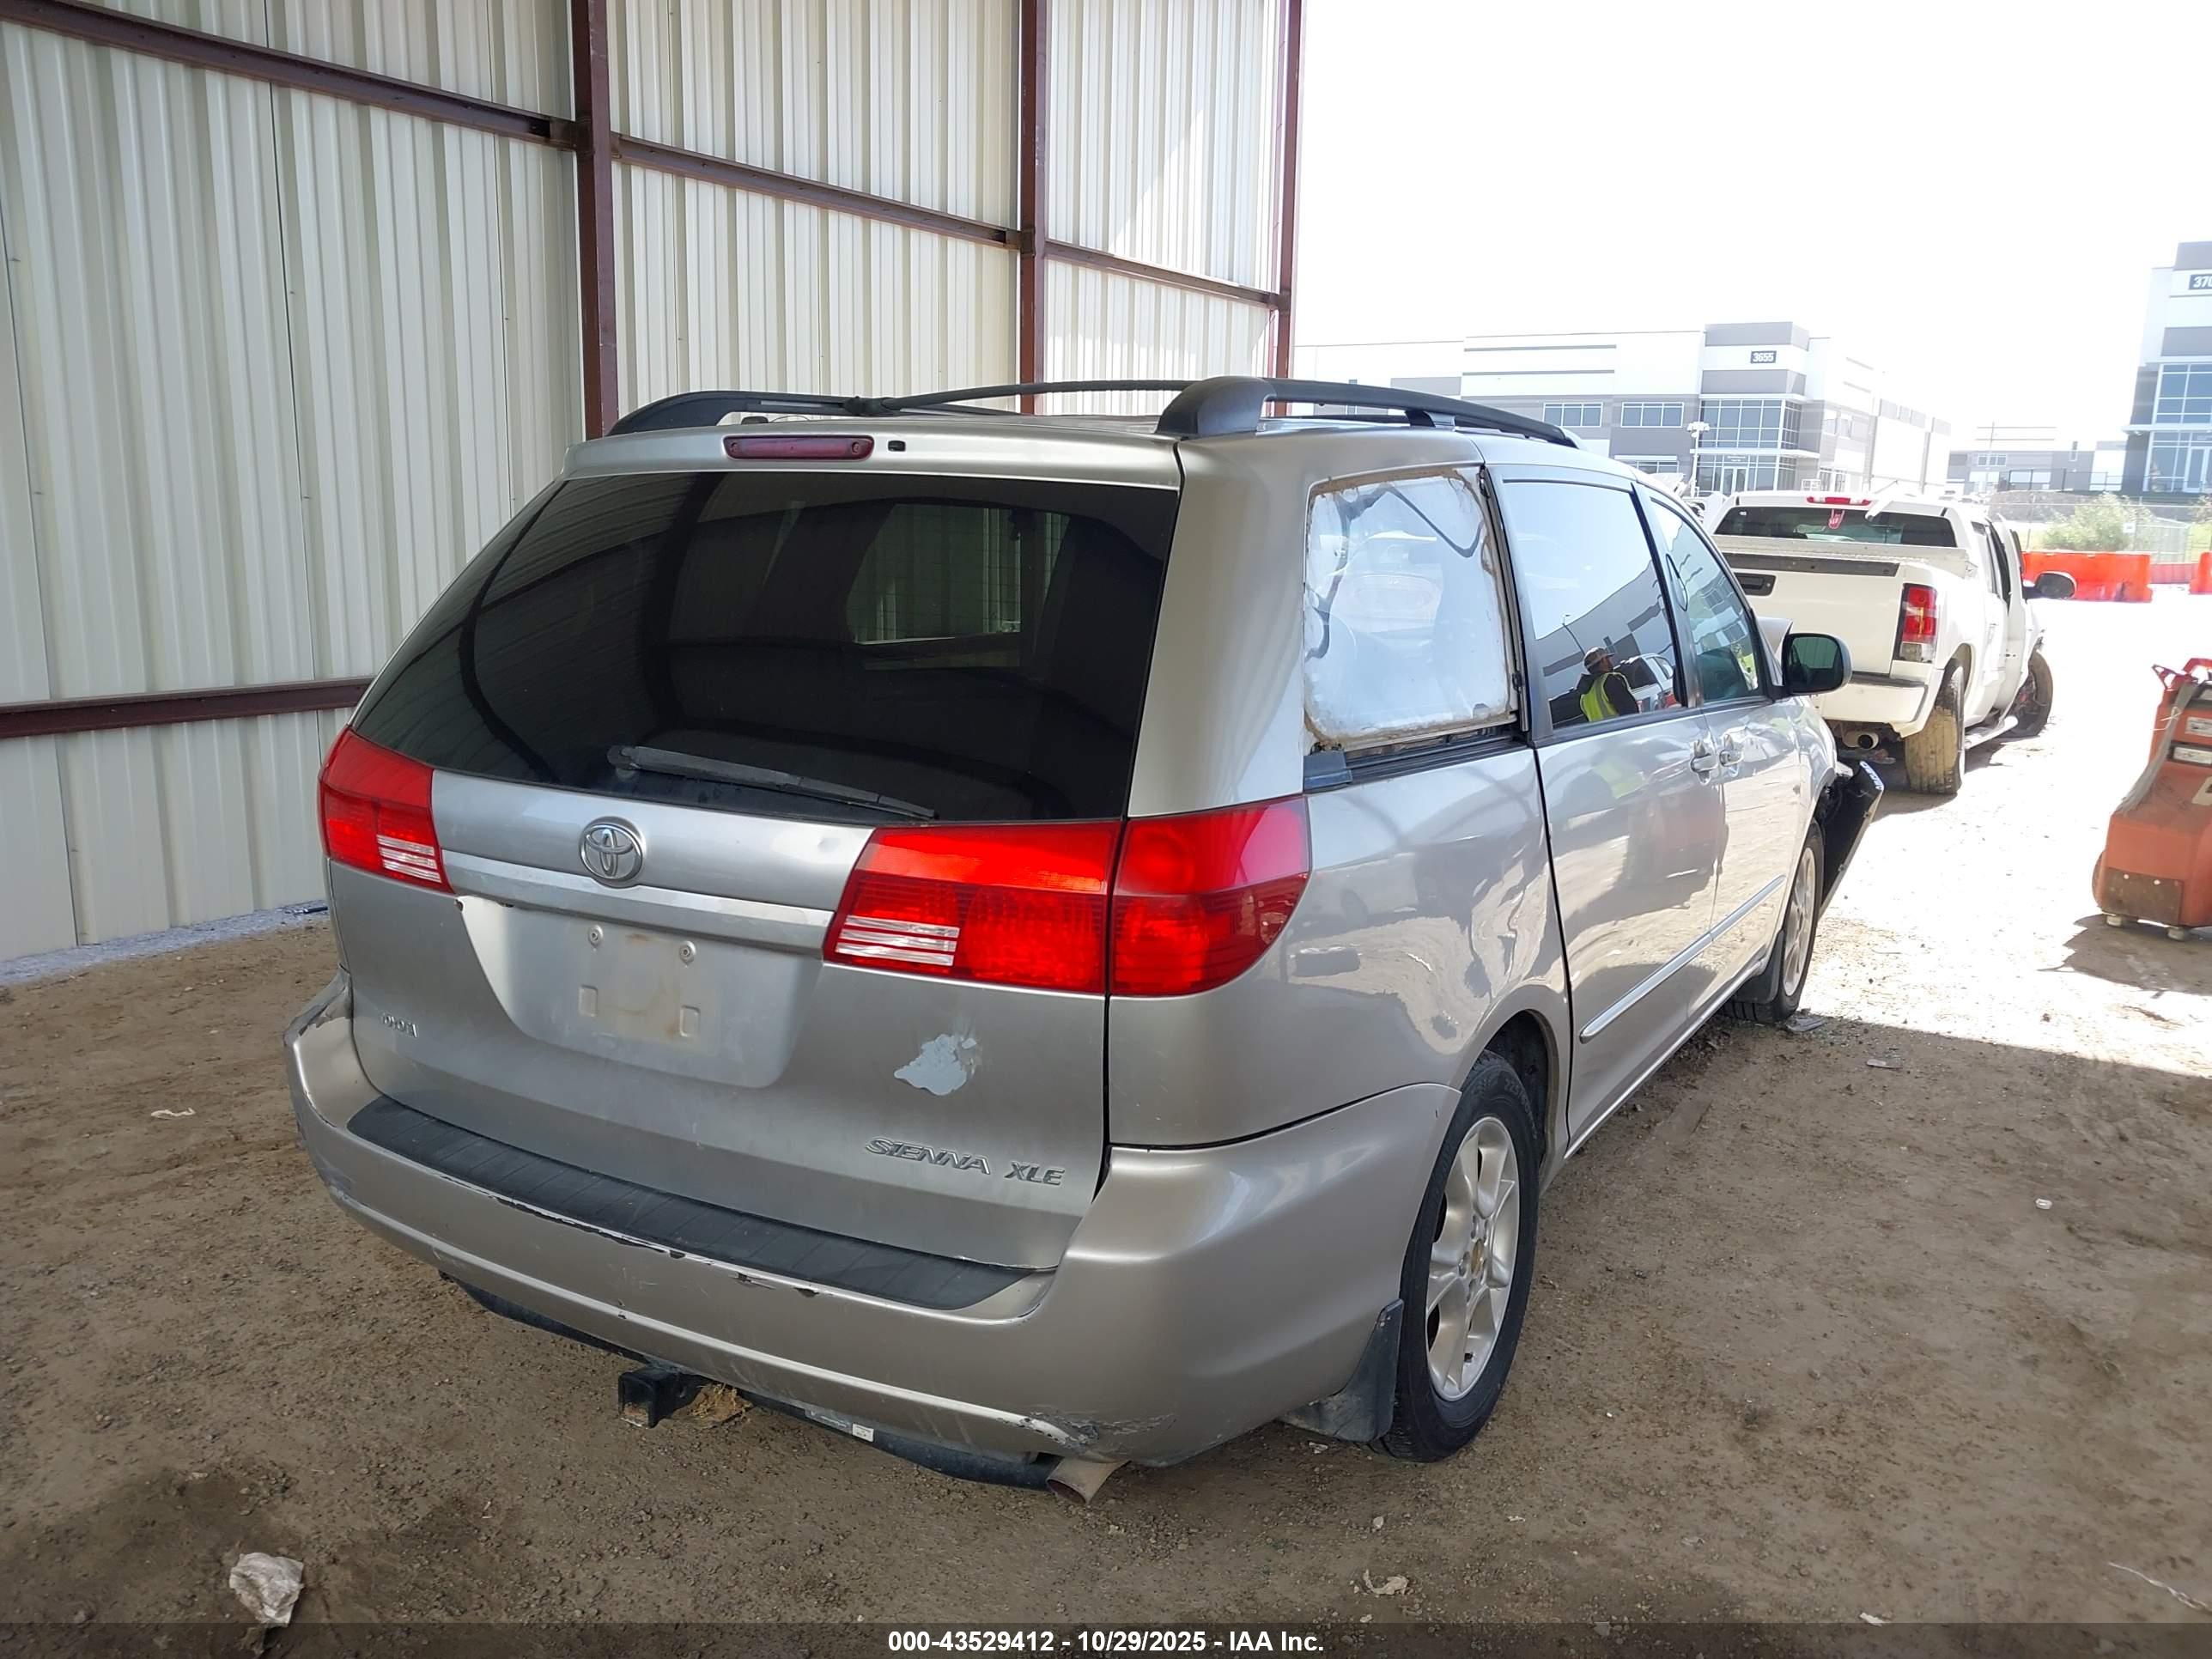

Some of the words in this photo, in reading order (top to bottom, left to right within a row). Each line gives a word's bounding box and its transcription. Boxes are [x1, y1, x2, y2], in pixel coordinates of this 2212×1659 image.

[1753, 352, 1775, 362] 3655
[865, 1138, 991, 1175] SIENNA
[1004, 1160, 1066, 1186] XLE
